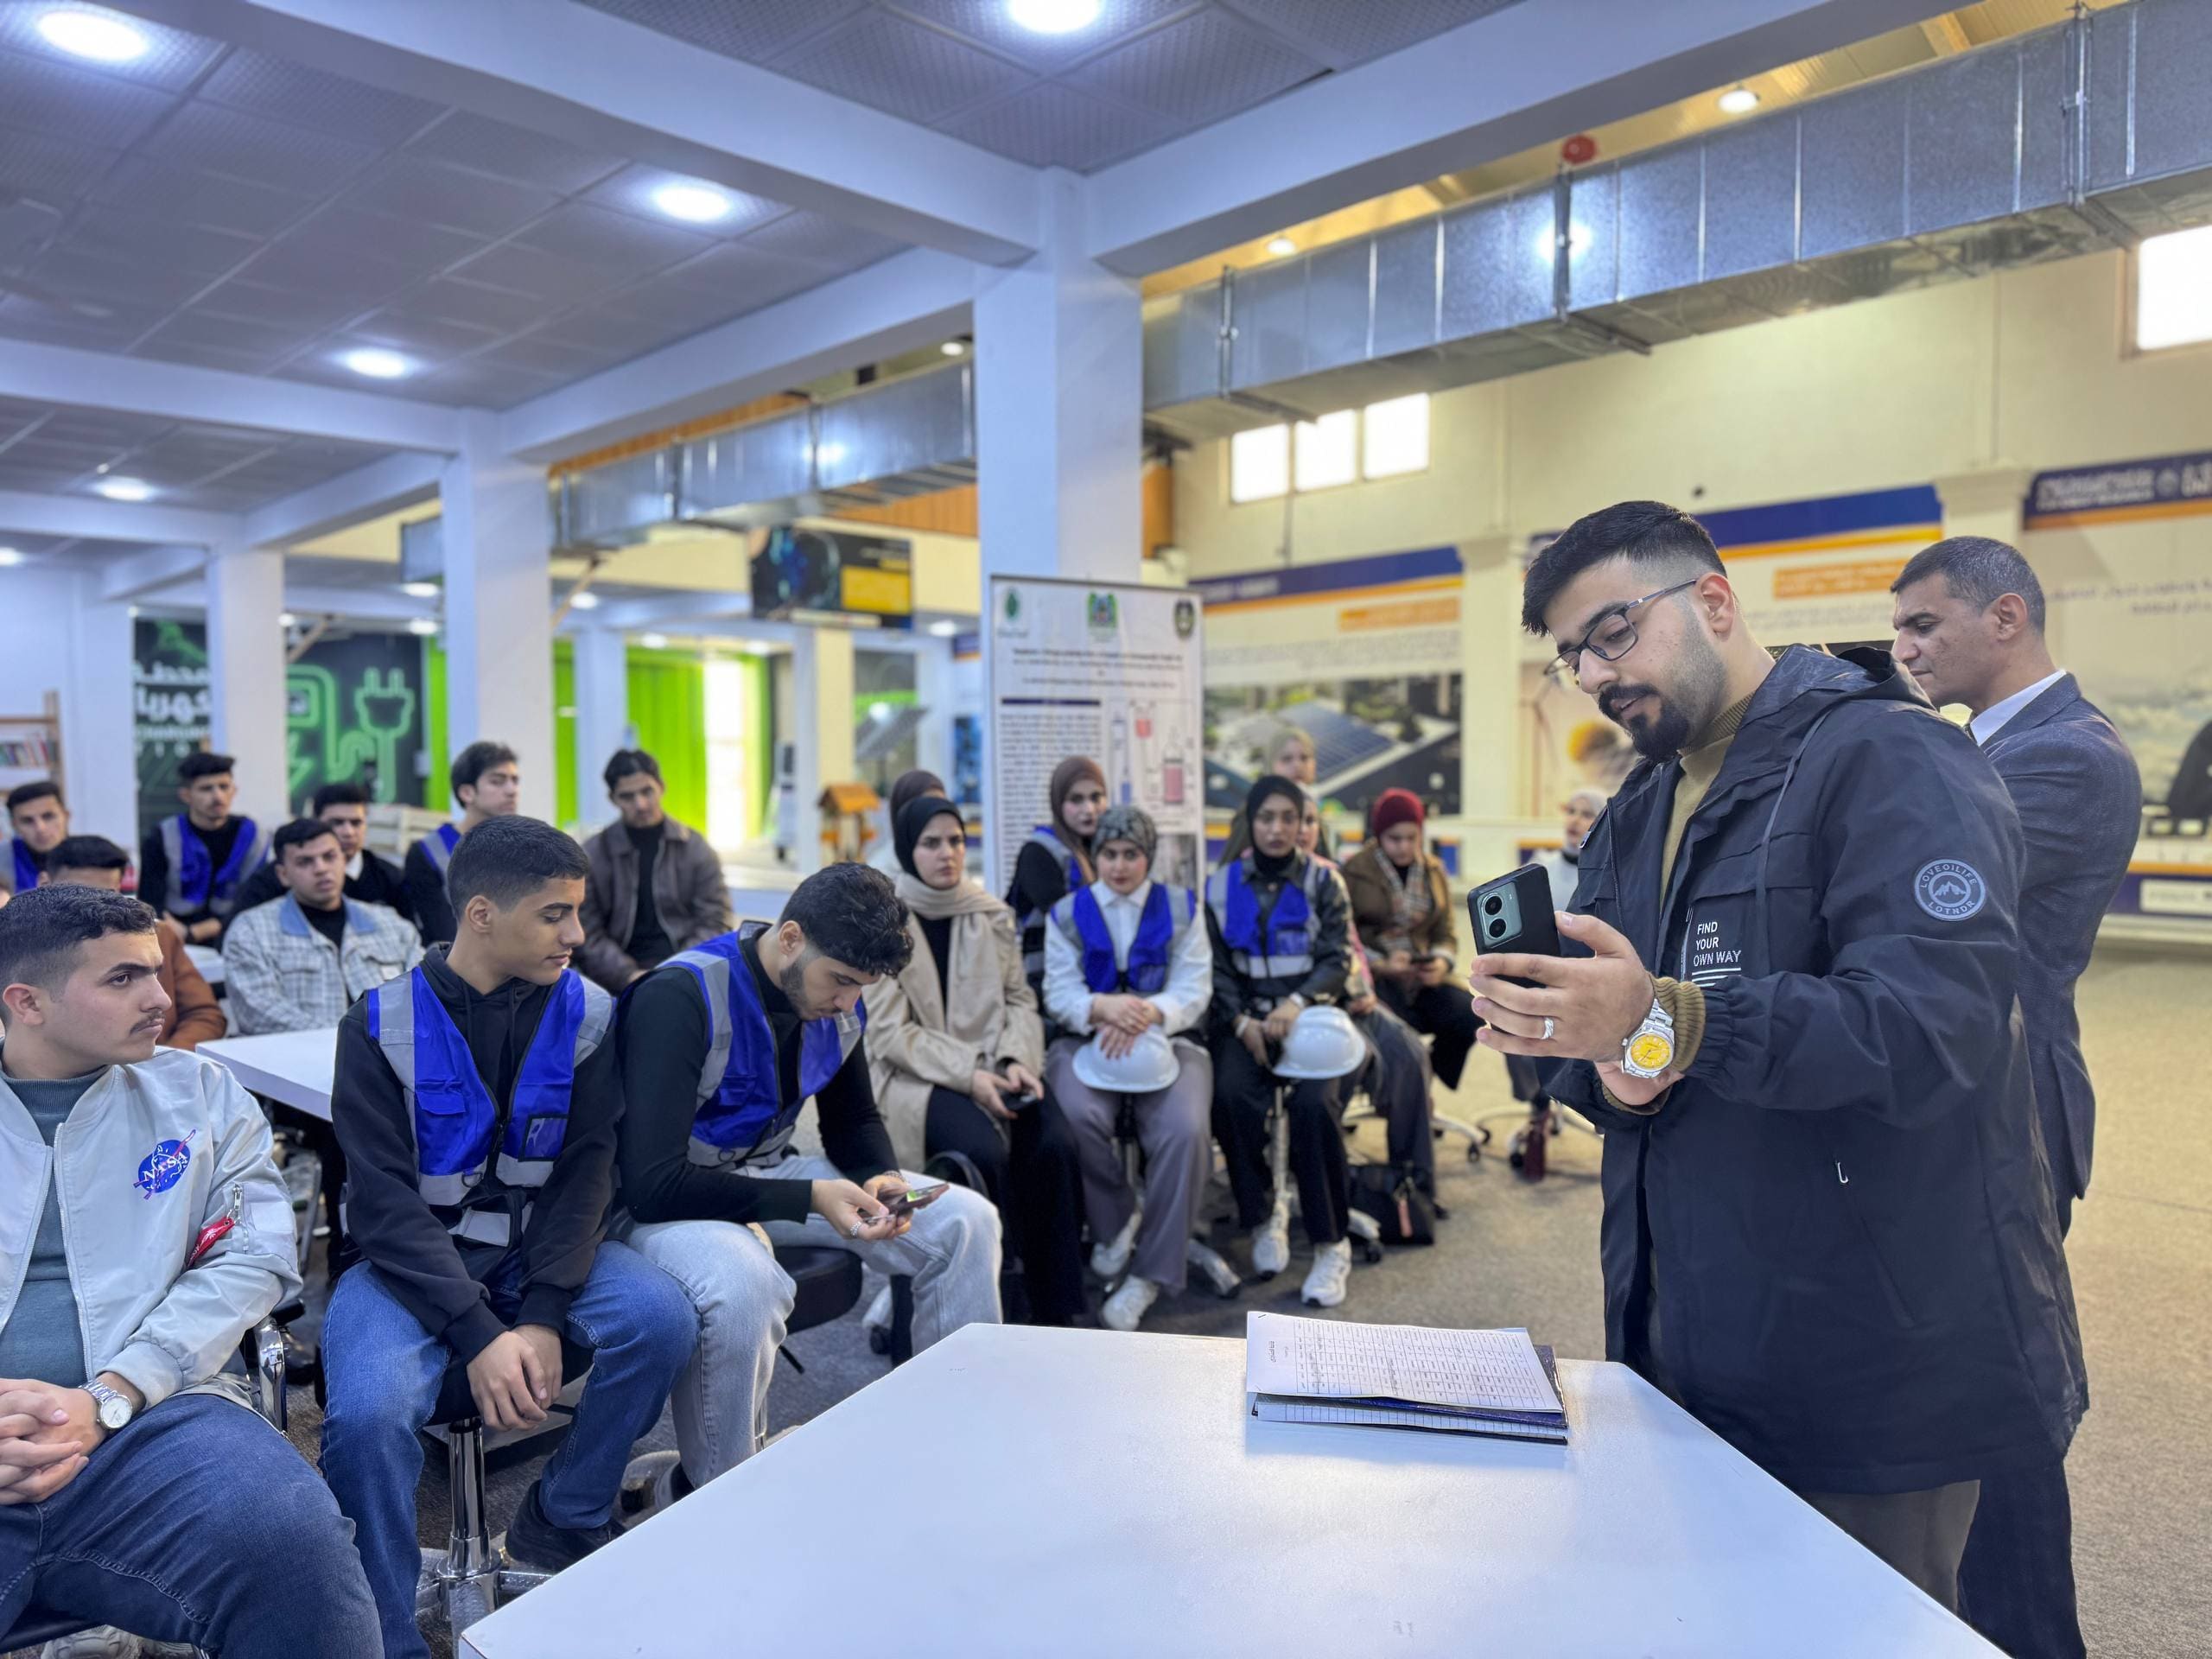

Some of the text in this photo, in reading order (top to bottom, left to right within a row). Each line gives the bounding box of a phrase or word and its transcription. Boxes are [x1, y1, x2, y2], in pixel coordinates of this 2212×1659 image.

[1920, 863, 1977, 888] LOVEOILIFE
[1697, 921, 1719, 935] FIND
[1695, 937, 1719, 951] YOUR
[1694, 950, 1742, 967] OWN WAY
[142, 1151, 188, 1181] NASA
